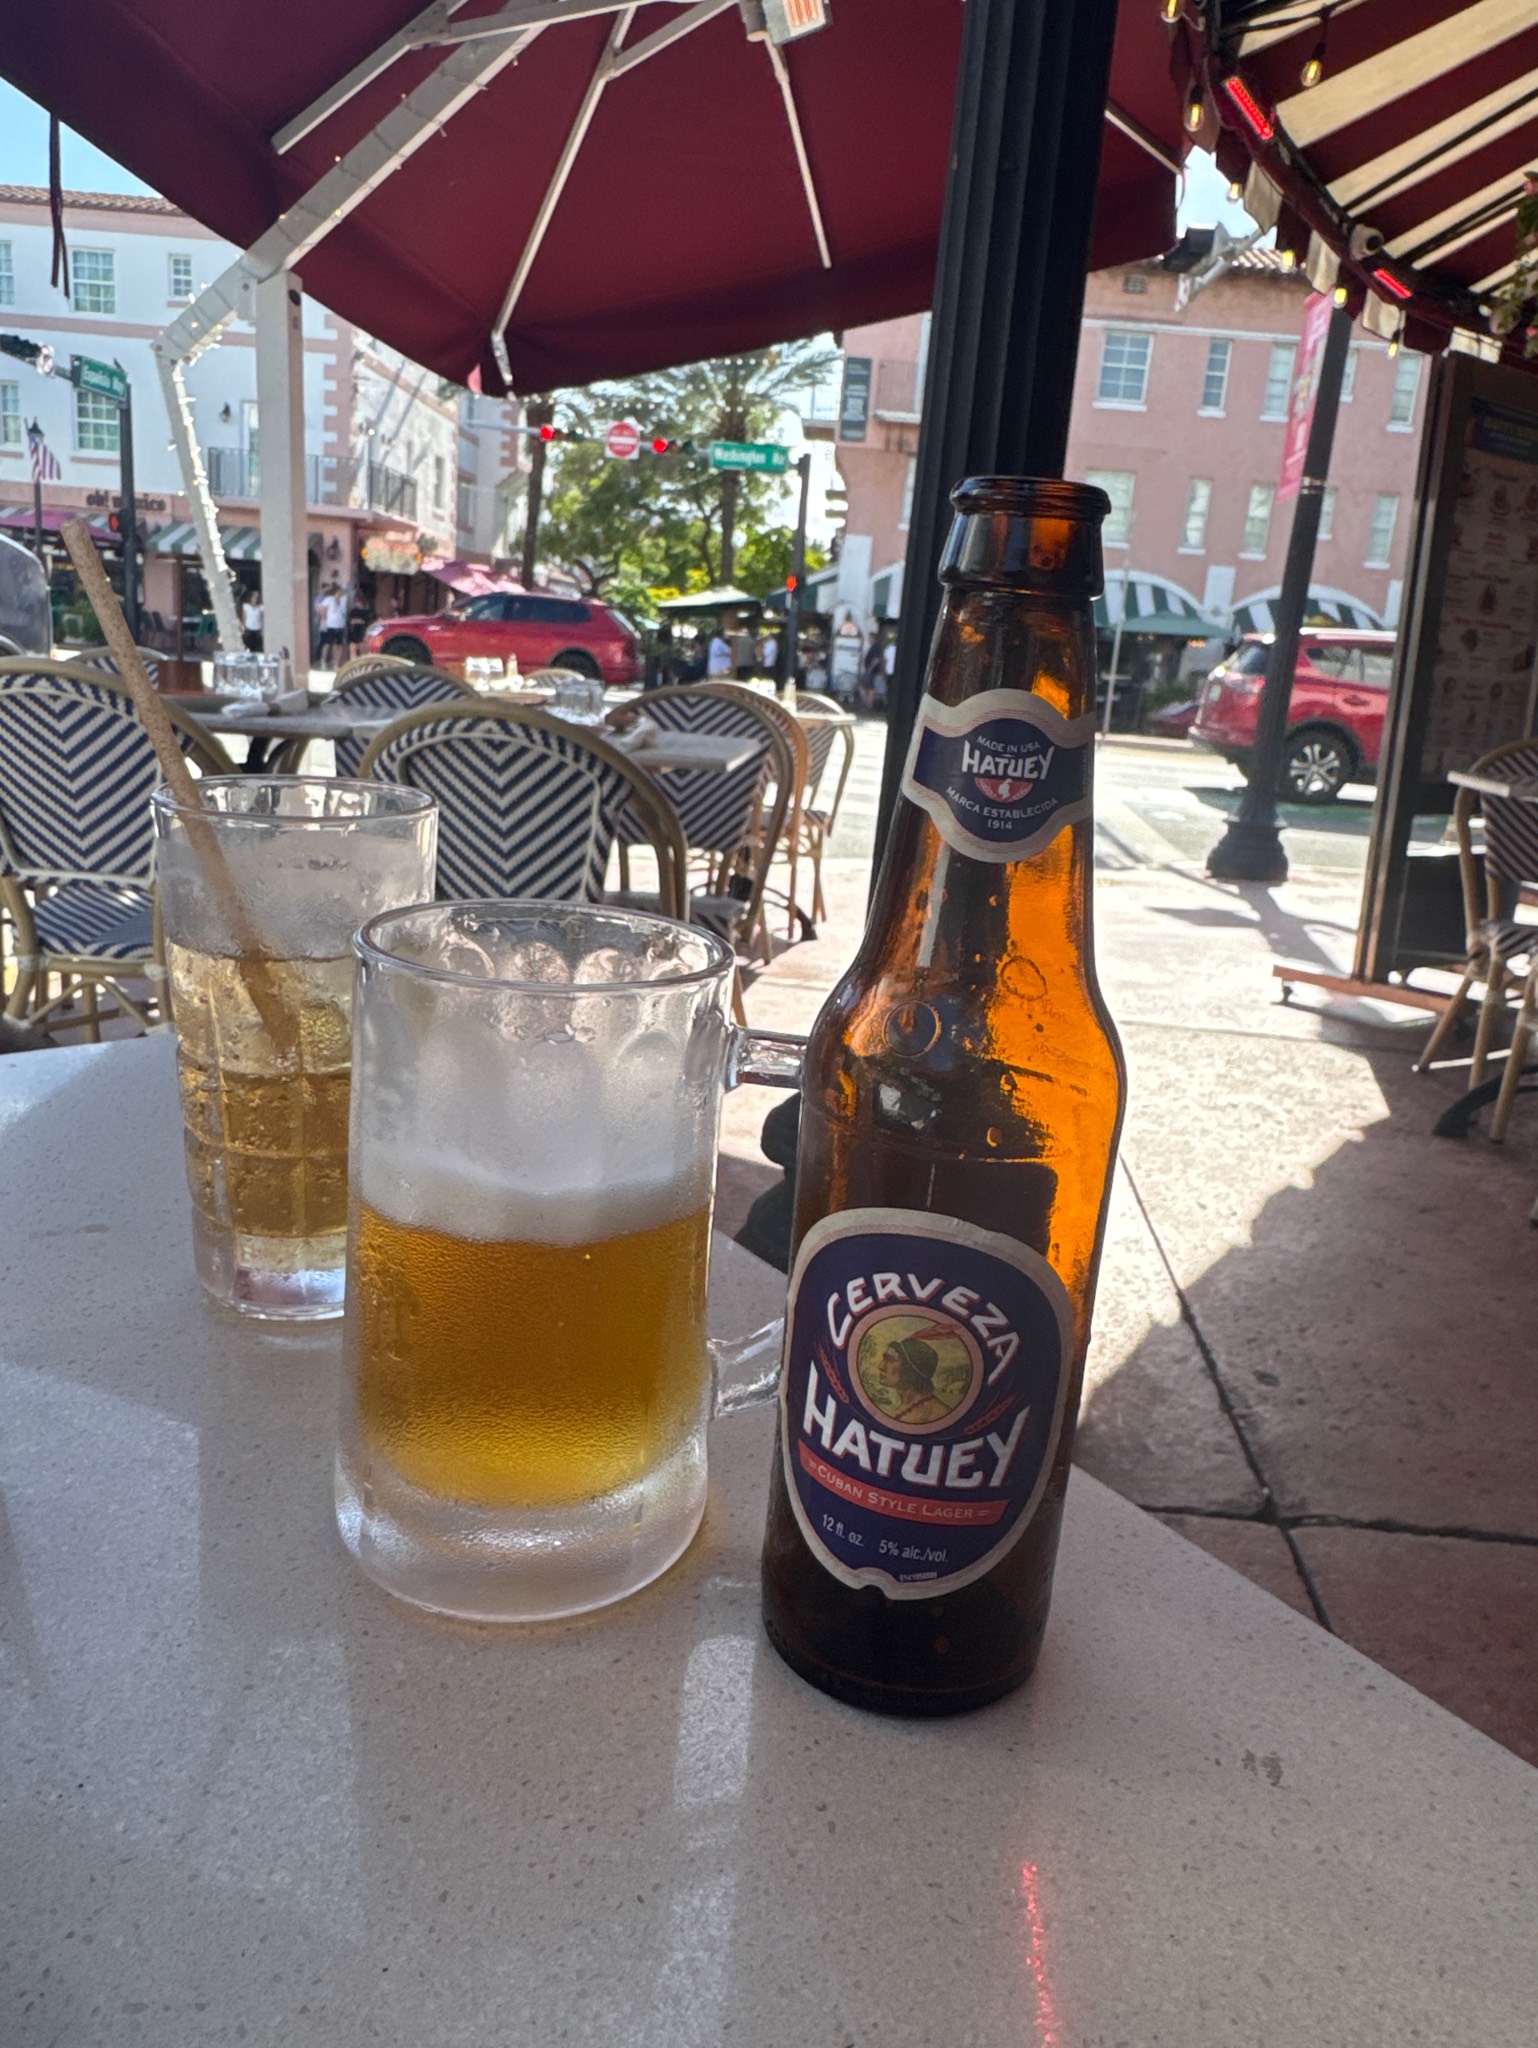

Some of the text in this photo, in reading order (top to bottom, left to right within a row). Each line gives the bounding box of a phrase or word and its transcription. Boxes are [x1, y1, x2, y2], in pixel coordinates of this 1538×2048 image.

[961, 739, 1055, 780] HATUEY
[977, 735, 1041, 753] MADE IN USA
[945, 786, 1059, 819] MARCA ESTABLECIDA
[987, 819, 1013, 830] 1914
[827, 1272, 1021, 1386] CERVEZA
[803, 1359, 1032, 1488] HATUEY
[817, 1464, 974, 1519] CUBAN STYLE LAGER
[822, 1513, 865, 1548] 12 fl. oz.
[879, 1538, 950, 1564] 5% alc./vol.
